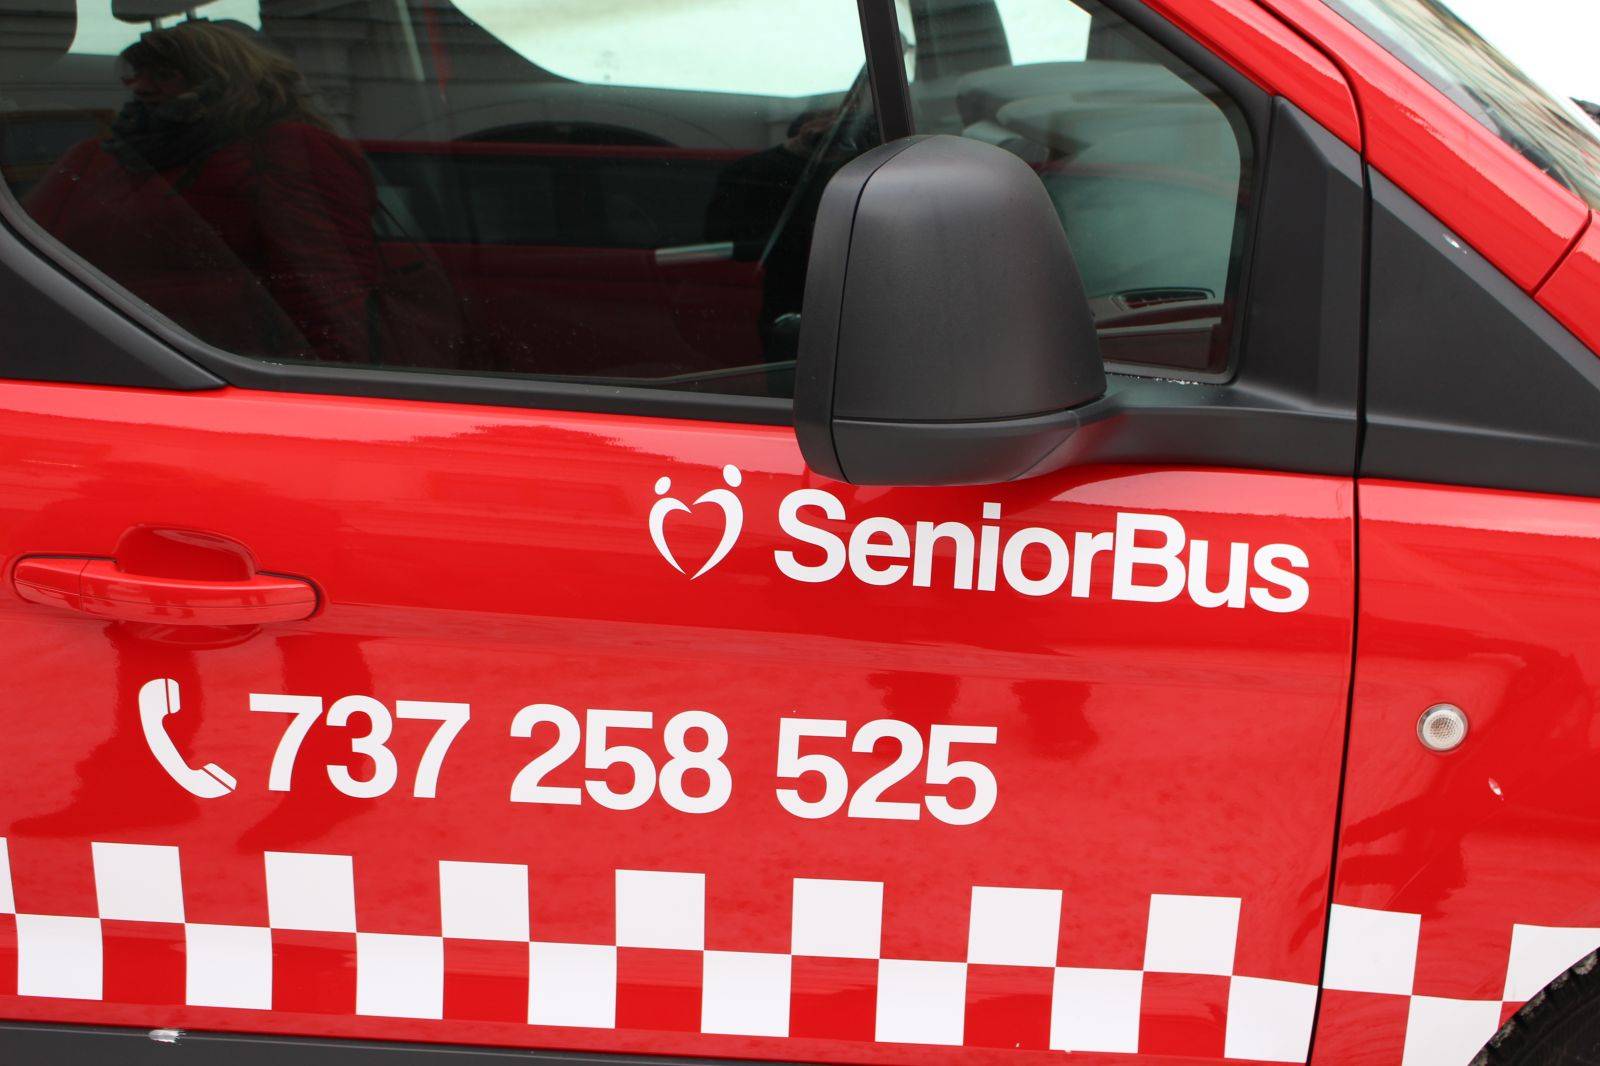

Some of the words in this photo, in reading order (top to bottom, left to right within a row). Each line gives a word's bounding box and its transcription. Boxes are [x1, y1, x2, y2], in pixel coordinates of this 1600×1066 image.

[774, 488, 1310, 613] SeniorBus
[249, 693, 471, 799] 737
[509, 703, 733, 814] 258
[775, 717, 998, 826] 525
